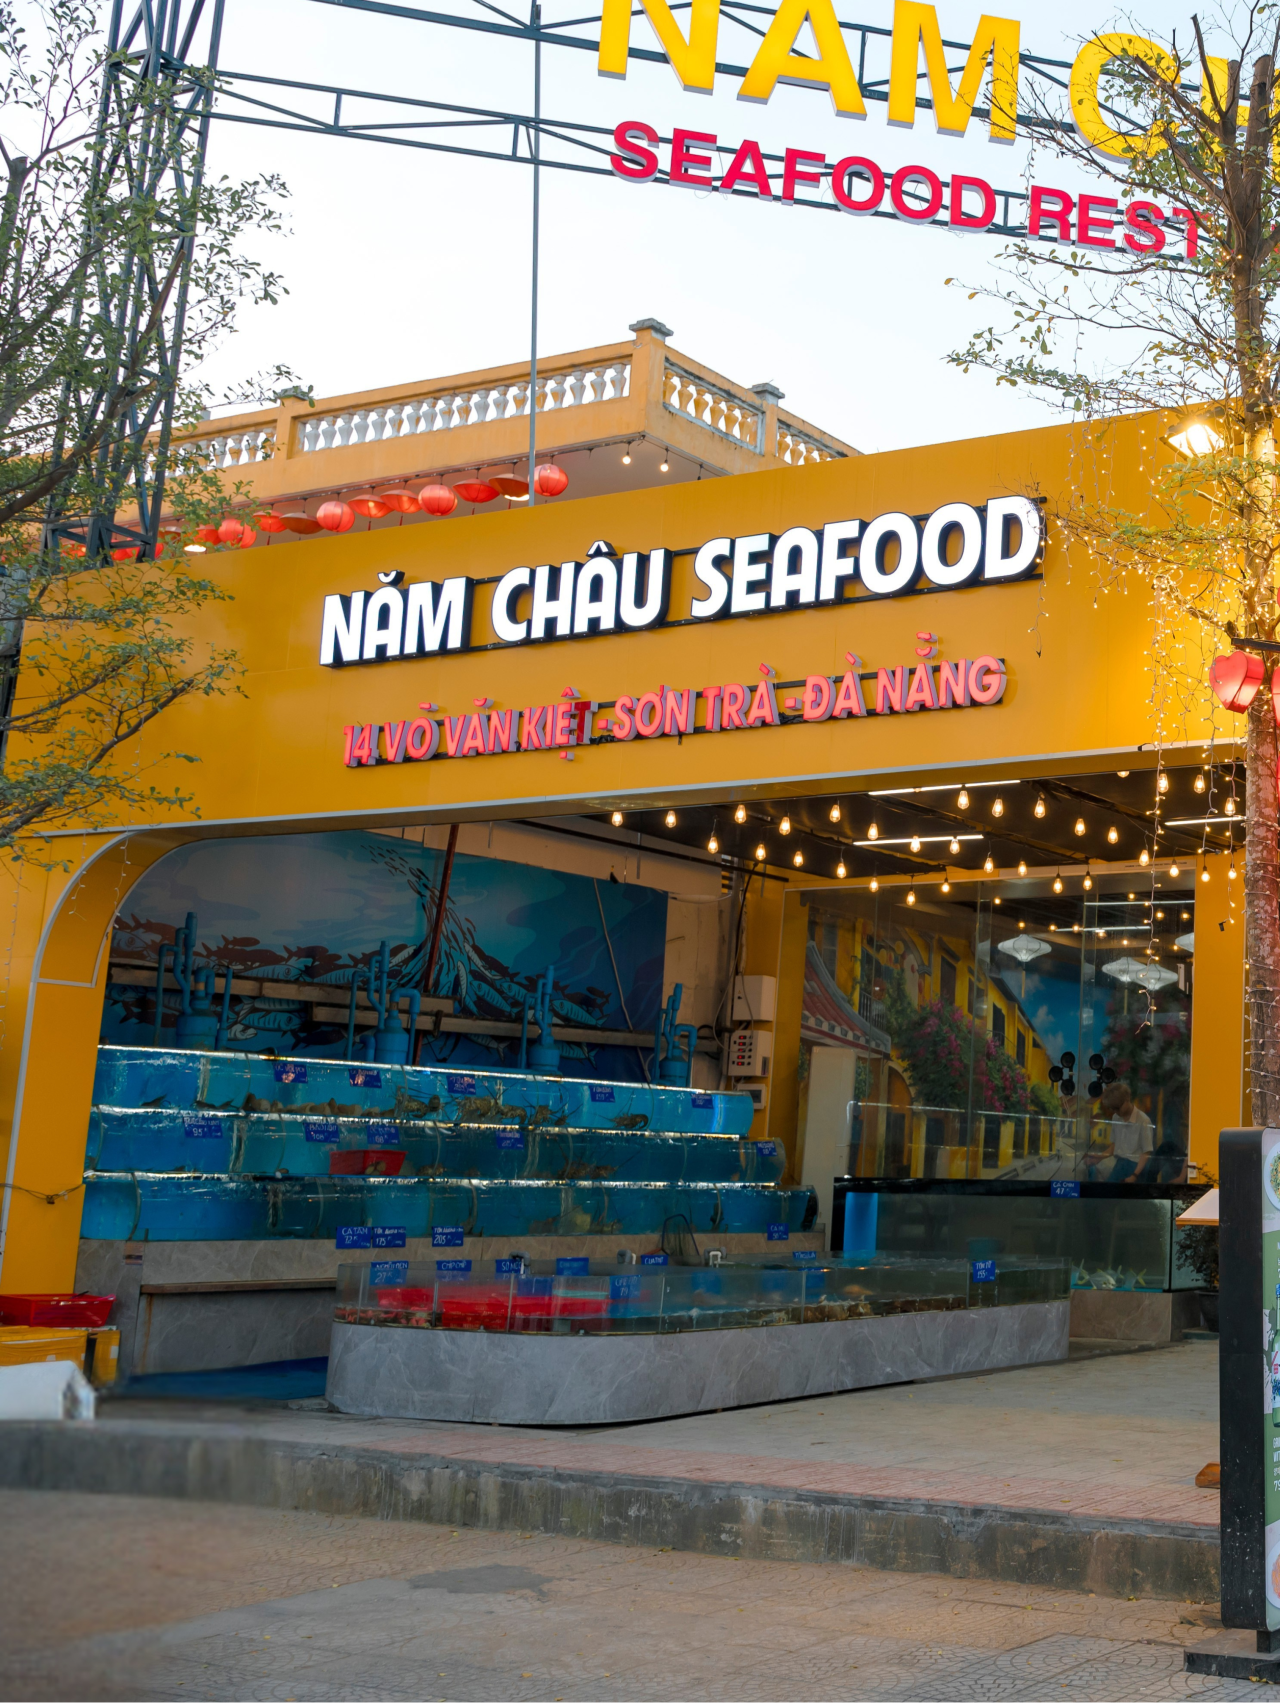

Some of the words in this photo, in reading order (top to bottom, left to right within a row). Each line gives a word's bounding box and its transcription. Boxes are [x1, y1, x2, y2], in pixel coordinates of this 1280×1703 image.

[610, 121, 997, 234] SEAFOOD
[320, 571, 473, 666] NĂM
[490, 540, 671, 644] CHÂU
[690, 495, 1046, 618] SEAFOOD
[344, 722, 388, 767] 14
